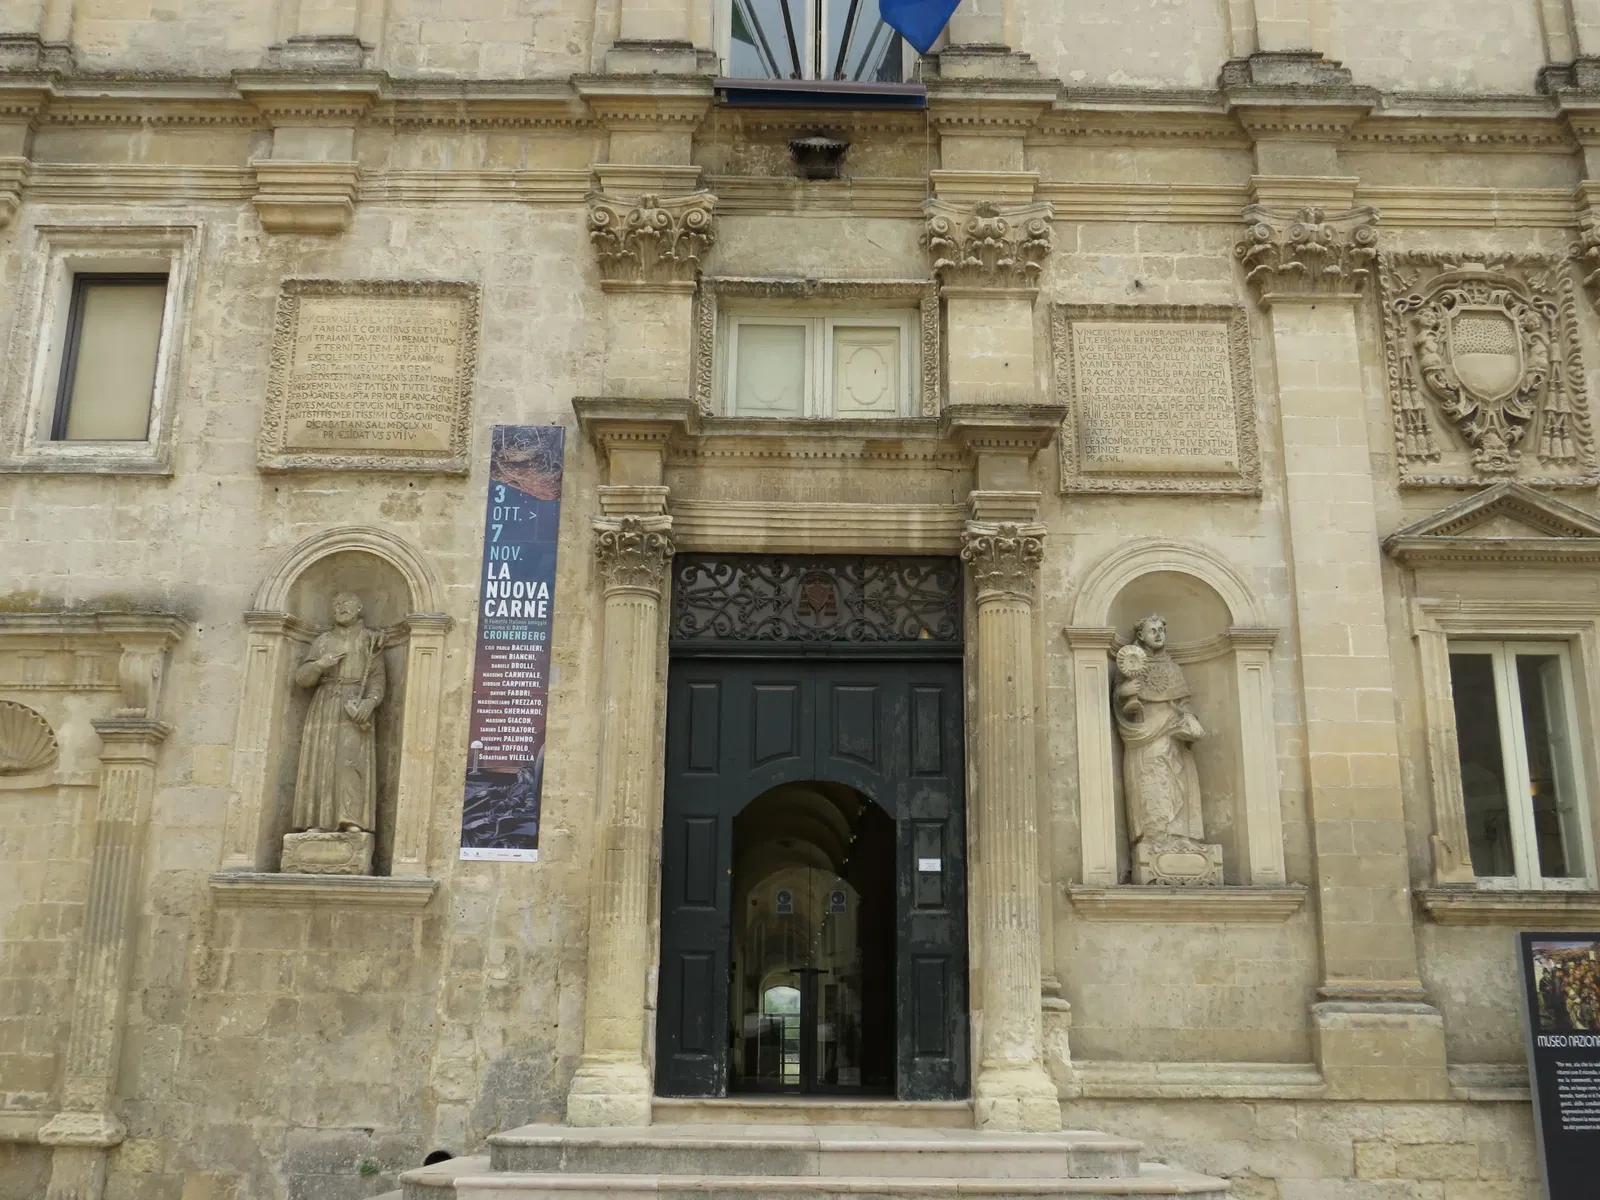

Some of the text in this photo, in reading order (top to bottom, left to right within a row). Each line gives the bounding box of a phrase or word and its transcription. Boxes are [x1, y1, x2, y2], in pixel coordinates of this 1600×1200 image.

[312, 324, 358, 333] RAMOSIS
[314, 334, 351, 342] TRAIANI
[1094, 385, 1135, 394] SACRVM
[1103, 411, 1132, 420] SACER
[1085, 444, 1121, 454] DEINDE
[494, 484, 506, 503] 3
[492, 506, 523, 521] OTT.
[491, 523, 503, 543] 7
[489, 545, 523, 562] NOV.
[487, 562, 511, 580] LA
[486, 580, 550, 600] NUOVA
[484, 599, 548, 619] CARNE
[483, 630, 546, 641] CRONENBERG
[1537, 1035, 1567, 1048] MUSEO
